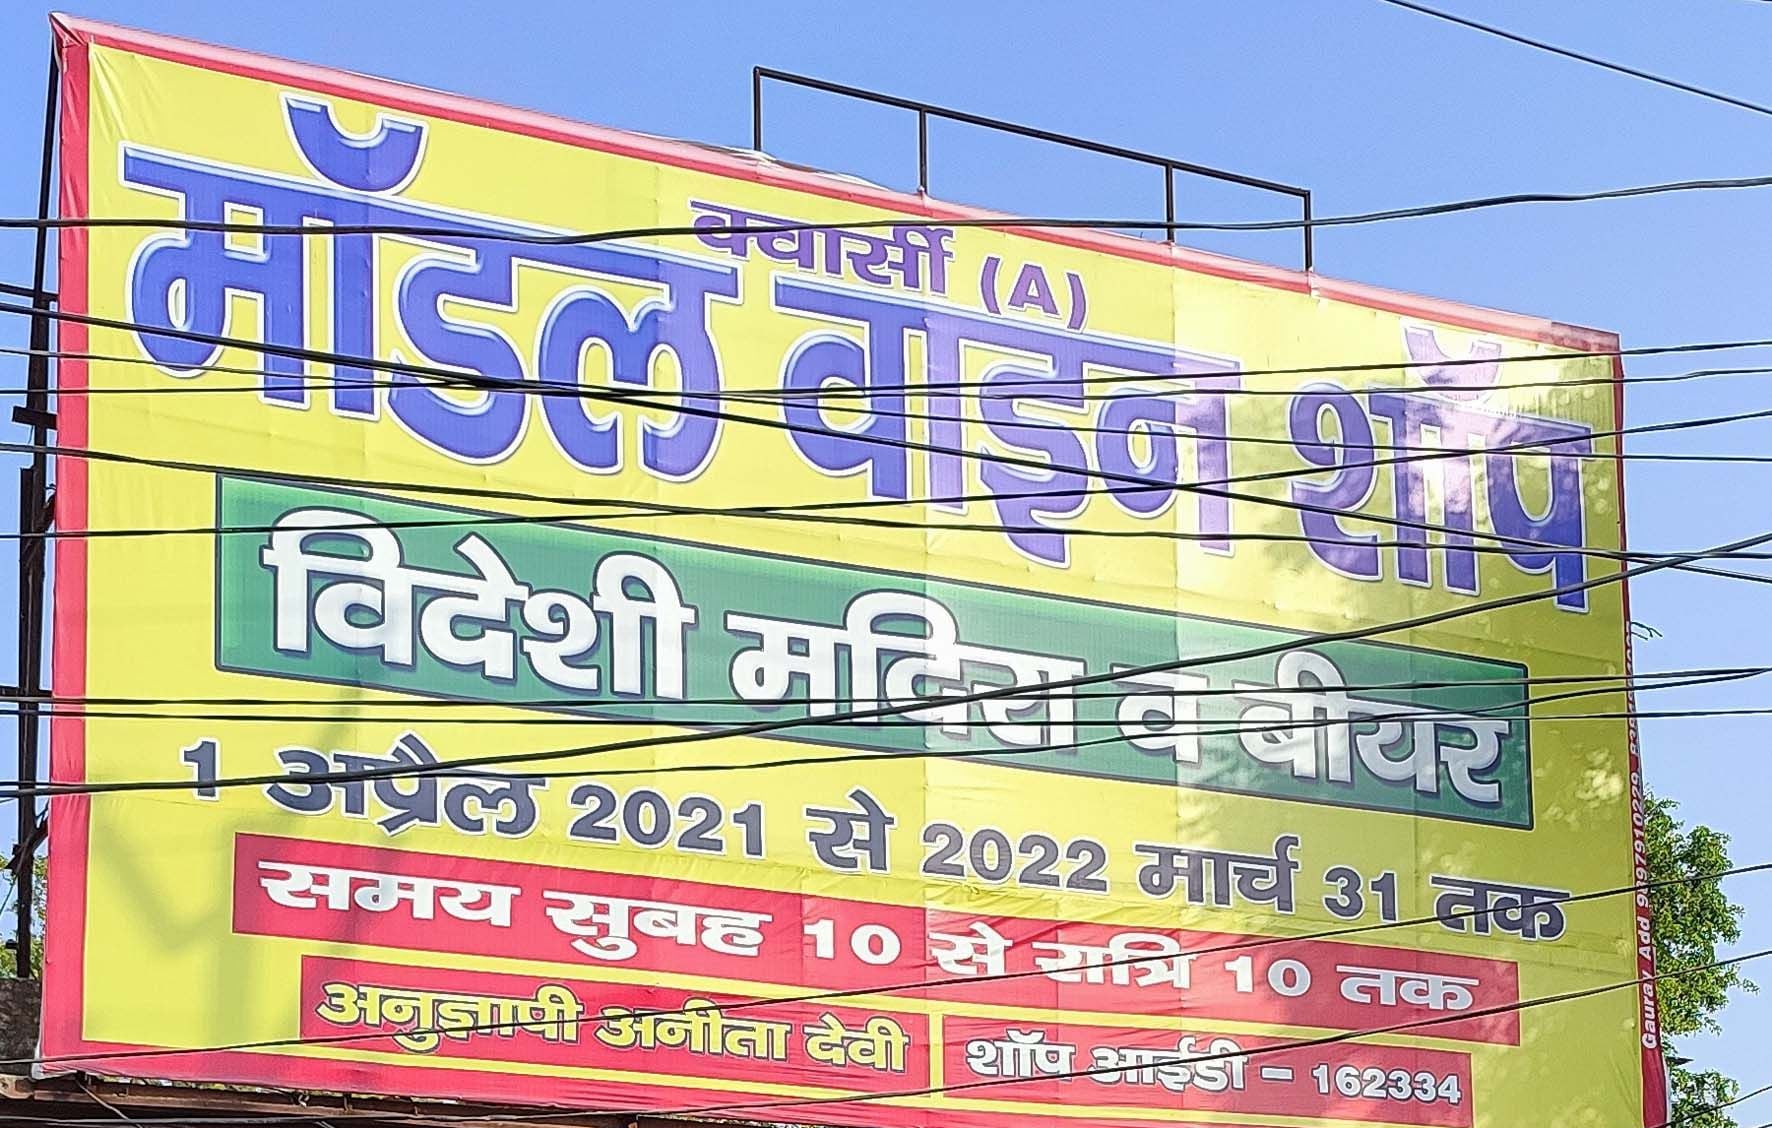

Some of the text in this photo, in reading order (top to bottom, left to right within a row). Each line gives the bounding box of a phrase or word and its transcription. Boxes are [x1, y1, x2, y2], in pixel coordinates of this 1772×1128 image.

[980, 255, 1088, 329] (A)
[120, 93, 1593, 611] मॉडल वाइन शॉप
[263, 506, 696, 700] विदेशी
[725, 591, 1084, 751] मदिरा
[1113, 666, 1208, 767] व
[1234, 651, 1510, 804] बीयर
[184, 731, 1570, 940] 1 अप्रैल 2021 से 2022 मार्च 31 तक
[258, 863, 1478, 1010] समय सुबह 10 से रात्रि 10 तक
[1637, 917, 1652, 957] Add
[316, 981, 909, 1073] अनुज्ञापी अनीता देवी
[965, 1029, 1076, 1081] शॉप
[1090, 1036, 1247, 1092] आईडी
[1314, 1064, 1462, 1107] 162334
